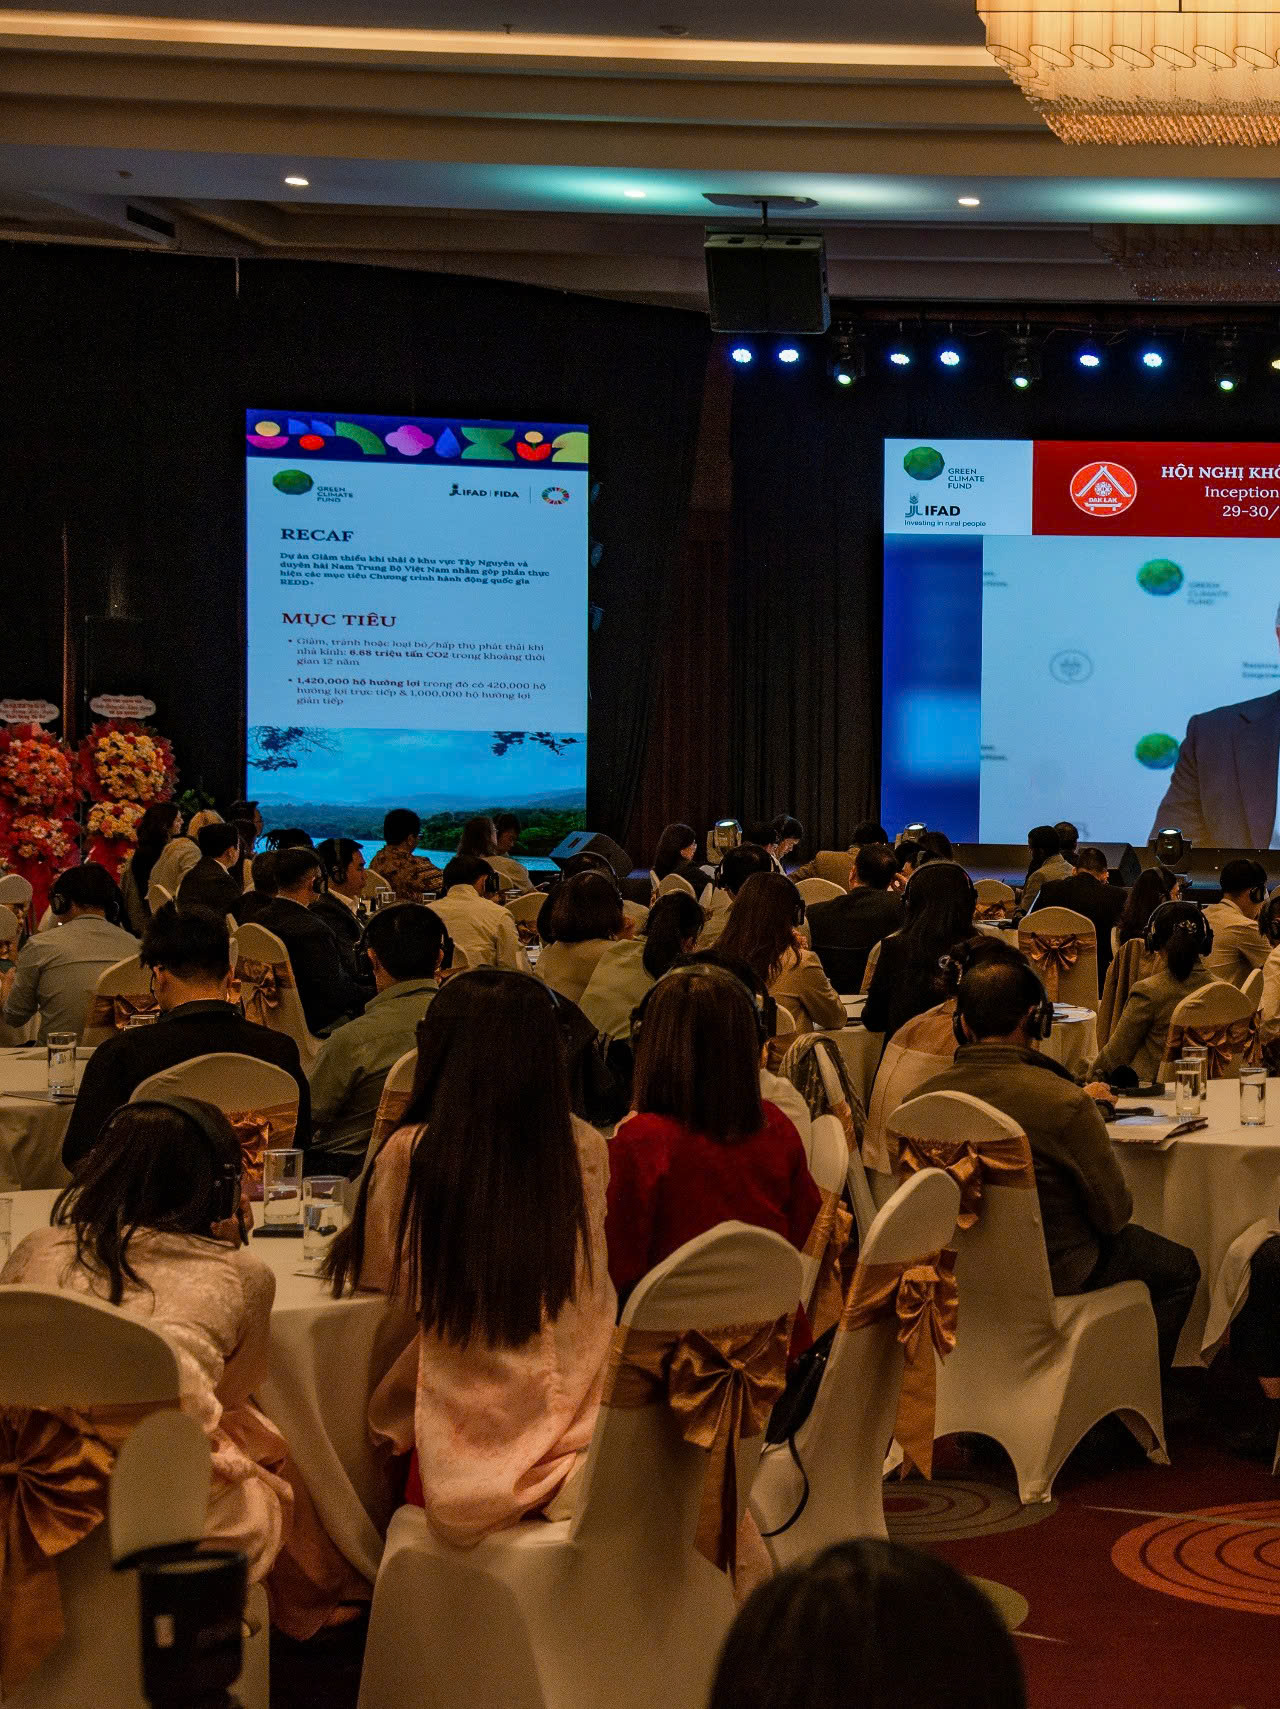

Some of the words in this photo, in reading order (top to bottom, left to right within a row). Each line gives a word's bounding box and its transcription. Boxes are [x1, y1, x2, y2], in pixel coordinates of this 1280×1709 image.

[1161, 463, 1194, 479] HỘI
[1199, 467, 1244, 482] NGHỊ
[462, 489, 487, 497] IFAD
[494, 490, 520, 498] FIDA
[1204, 486, 1280, 499] Inception
[925, 505, 960, 516] IFAD
[280, 528, 354, 541] RECAF
[280, 552, 294, 560] Dự
[458, 559, 476, 567] Tây
[478, 560, 515, 568] Nguyên
[280, 561, 310, 569] duyên
[356, 564, 387, 572] Trung
[389, 565, 402, 573] Bộ
[369, 573, 407, 582] Chương
[464, 576, 488, 584] động
[282, 613, 336, 627] MỤC
[342, 611, 397, 627] TIÊU
